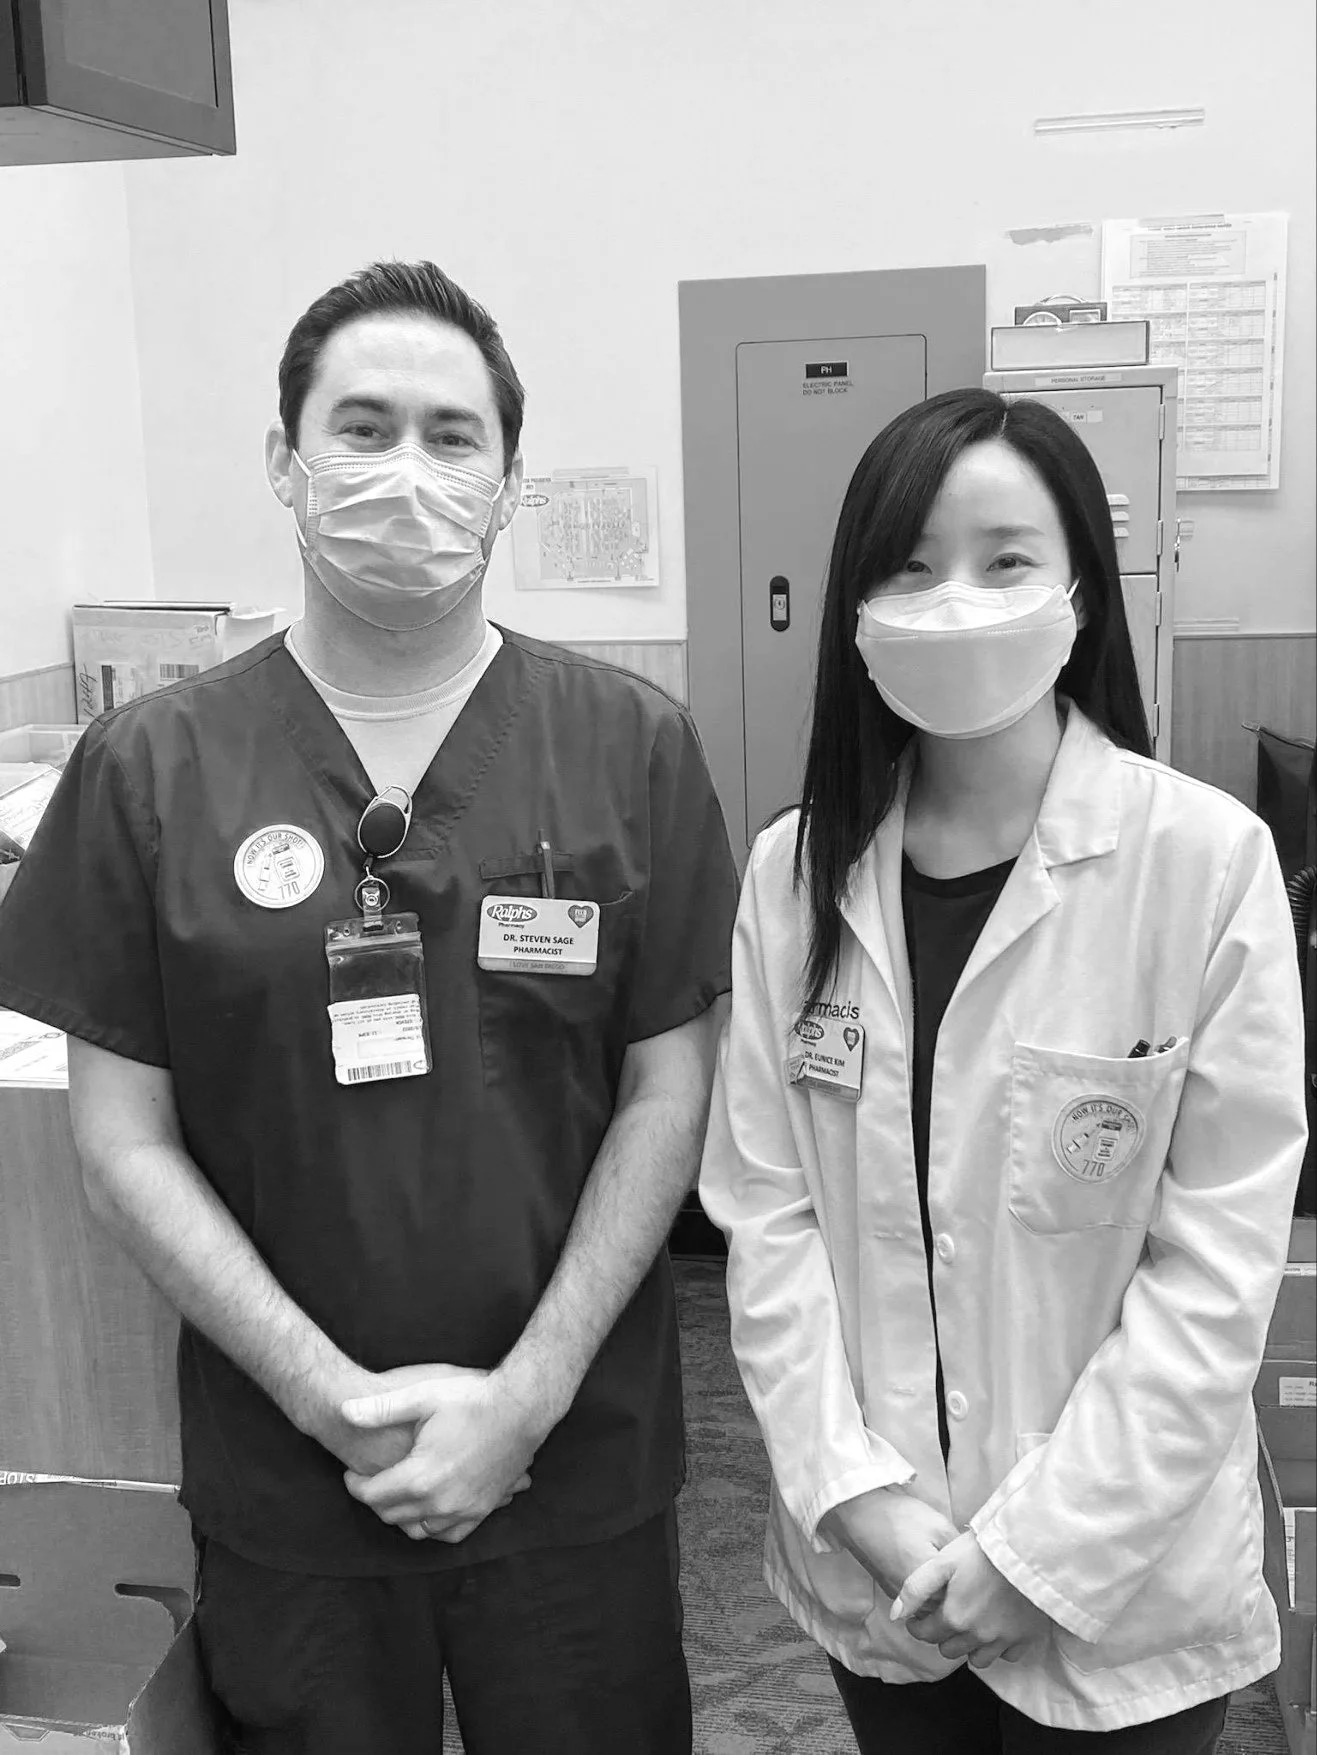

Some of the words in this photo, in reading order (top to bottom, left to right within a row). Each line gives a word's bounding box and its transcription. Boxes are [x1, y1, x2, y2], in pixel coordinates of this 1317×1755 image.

[247, 848, 257, 865] NOW
[268, 832, 282, 842] OUR
[279, 881, 300, 900] 770
[492, 905, 532, 922] Ralphs
[503, 934, 518, 942] DR.
[520, 935, 550, 944] STEVEN
[552, 936, 574, 945] SAGE
[514, 946, 563, 956] PHARMACIST
[808, 1064, 839, 1077] PHARMACIST
[1072, 1106, 1088, 1120] NOW
[1083, 1159, 1105, 1176] 770
